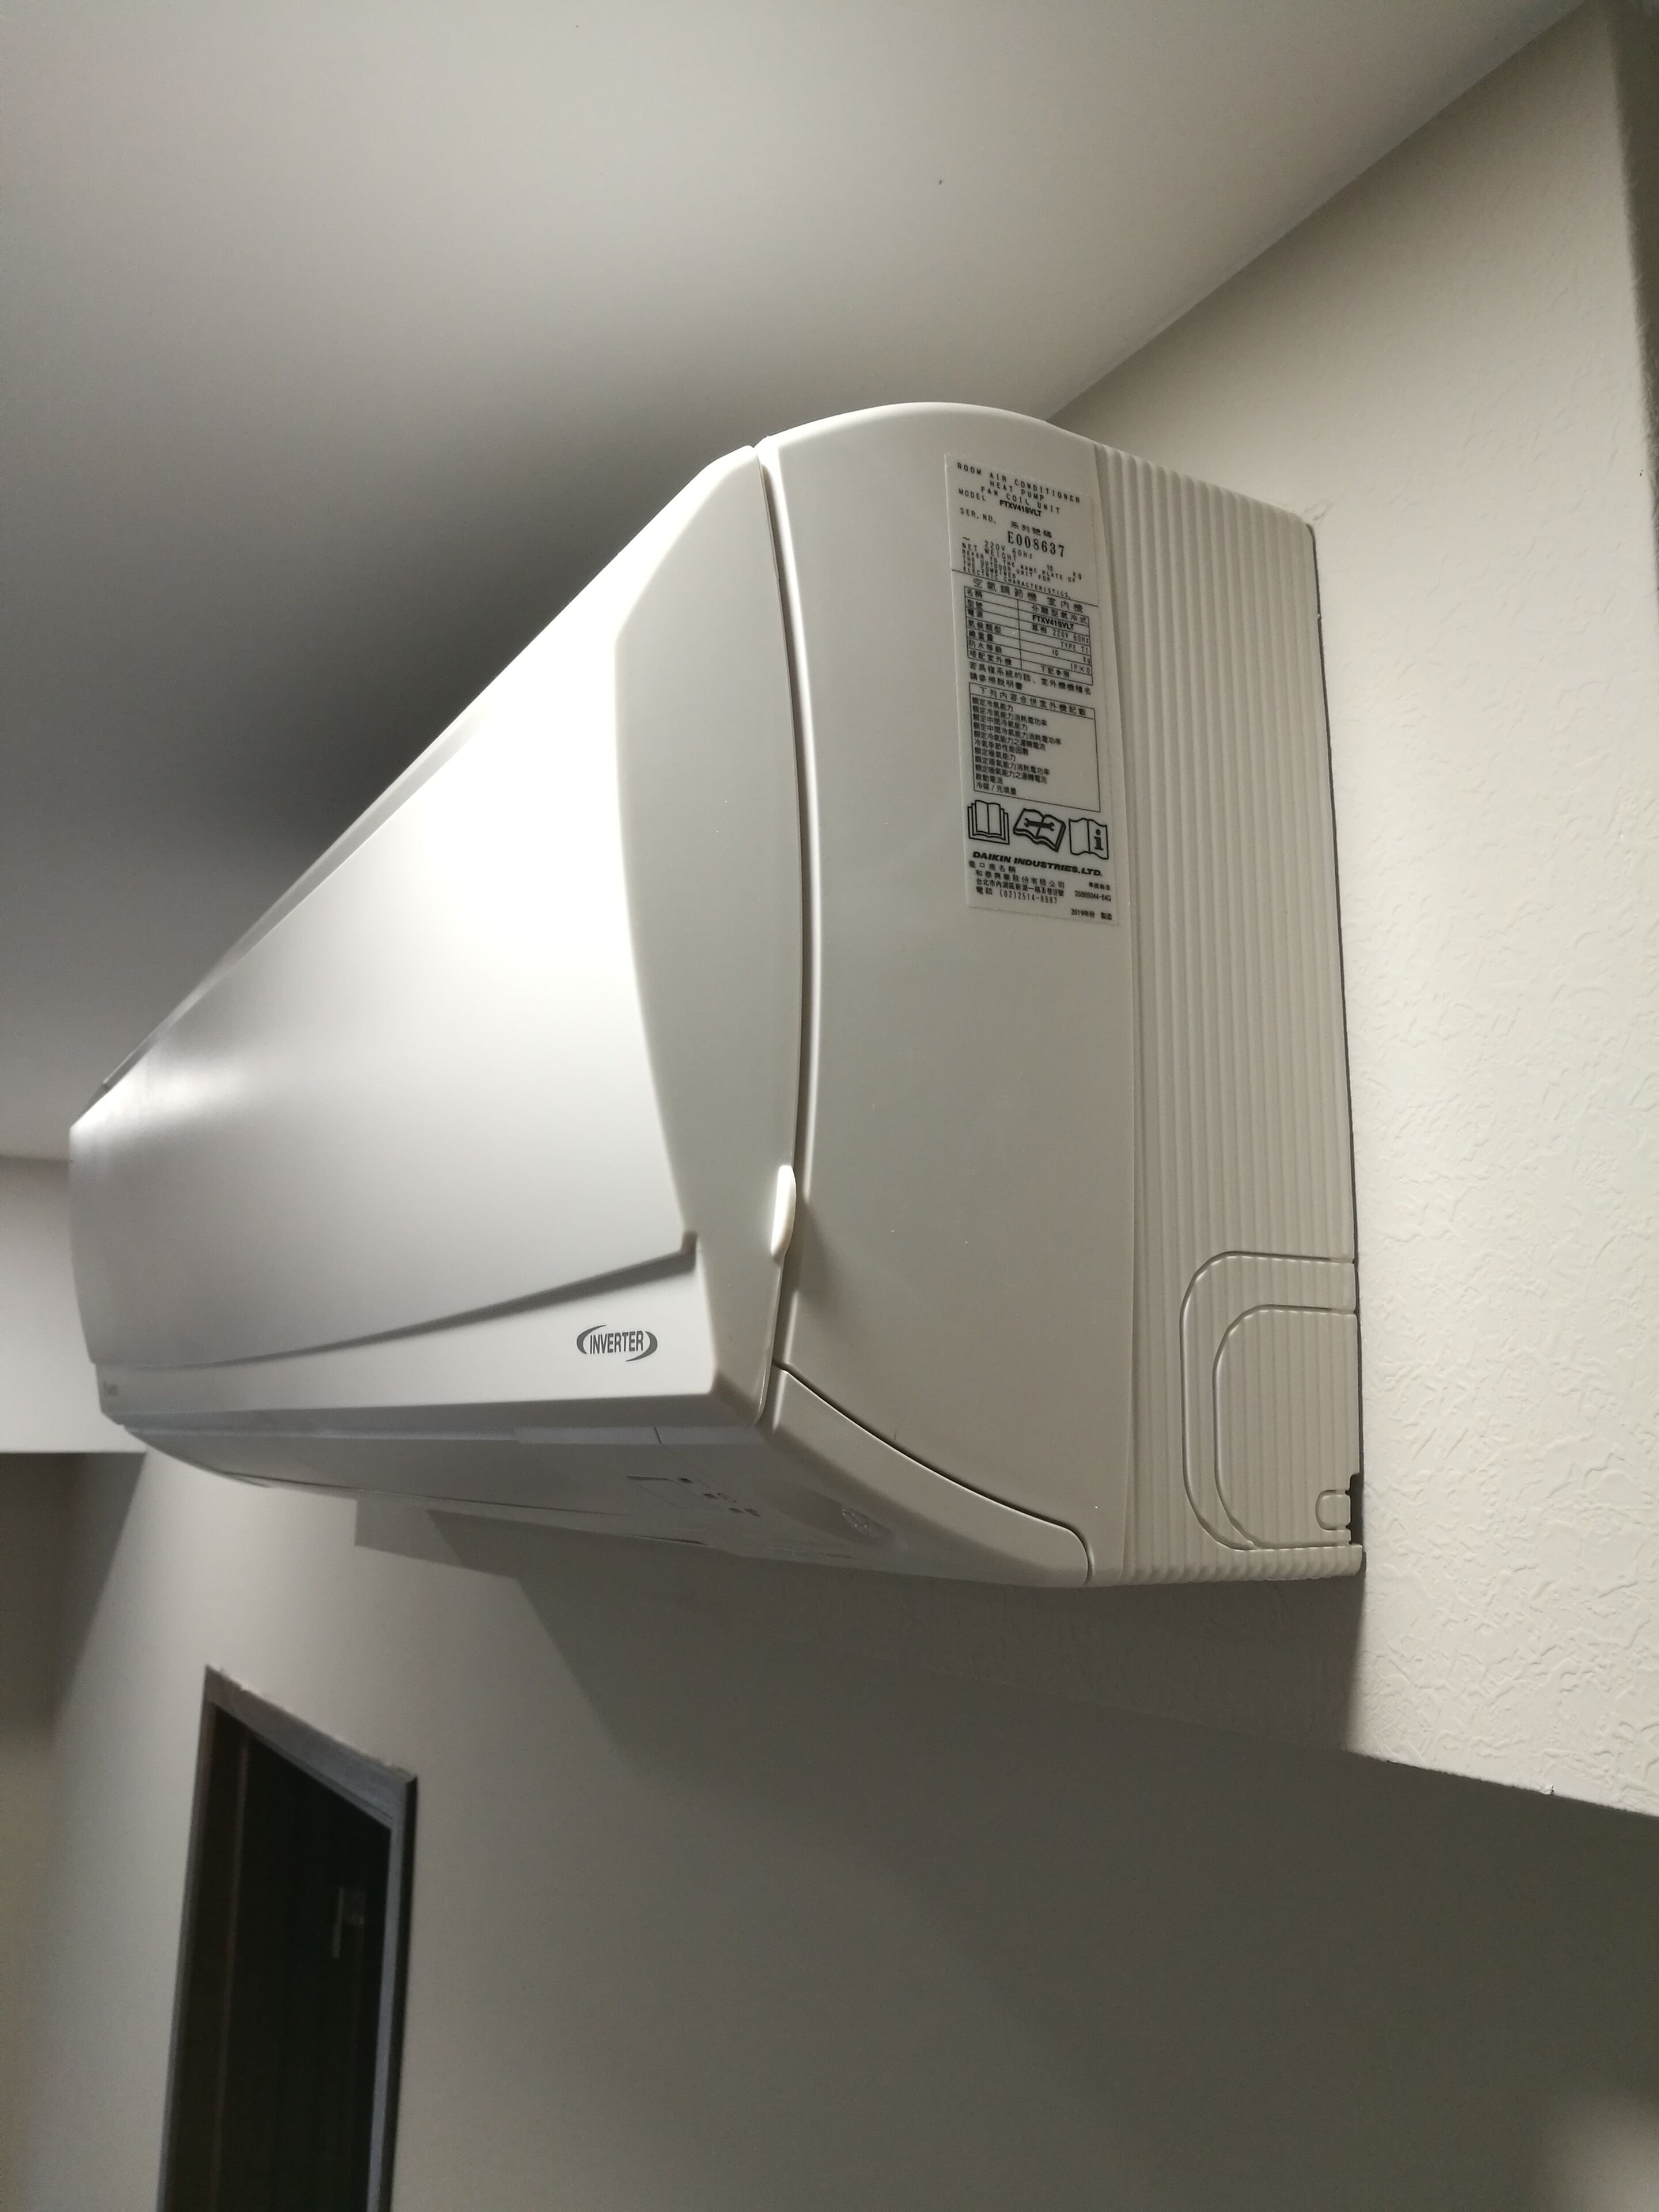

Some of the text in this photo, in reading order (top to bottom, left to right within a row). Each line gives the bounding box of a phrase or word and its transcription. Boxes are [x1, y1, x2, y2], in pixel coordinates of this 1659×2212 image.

[957, 463, 1081, 503] ROOM AIR CONDITIONER
[990, 480, 1044, 501] HEAT PUMP
[959, 488, 1042, 517] MODEL FTXV41SVLT
[981, 486, 1060, 514] FAN COIL UNIT
[962, 542, 977, 552] NET
[984, 548, 1017, 562] WEIGHT
[984, 540, 1033, 559] 220V 60Hz
[1007, 531, 1065, 558] E008637
[962, 549, 984, 559] REFER
[1003, 559, 1015, 567] THE
[1020, 565, 1037, 574] NAME
[1041, 570, 1063, 580] PLATE
[963, 555, 975, 563] THE
[1016, 569, 1033, 578] UNIT
[1032, 614, 1075, 630] FTXV41SVLT
[1053, 627, 1069, 638] 220V
[1073, 633, 1090, 644] 60Hz
[1060, 640, 1077, 652] TYPE
[1081, 646, 1089, 654] T1
[972, 851, 1011, 863] DAIKIN
[590, 1330, 643, 1355] INVERTER
